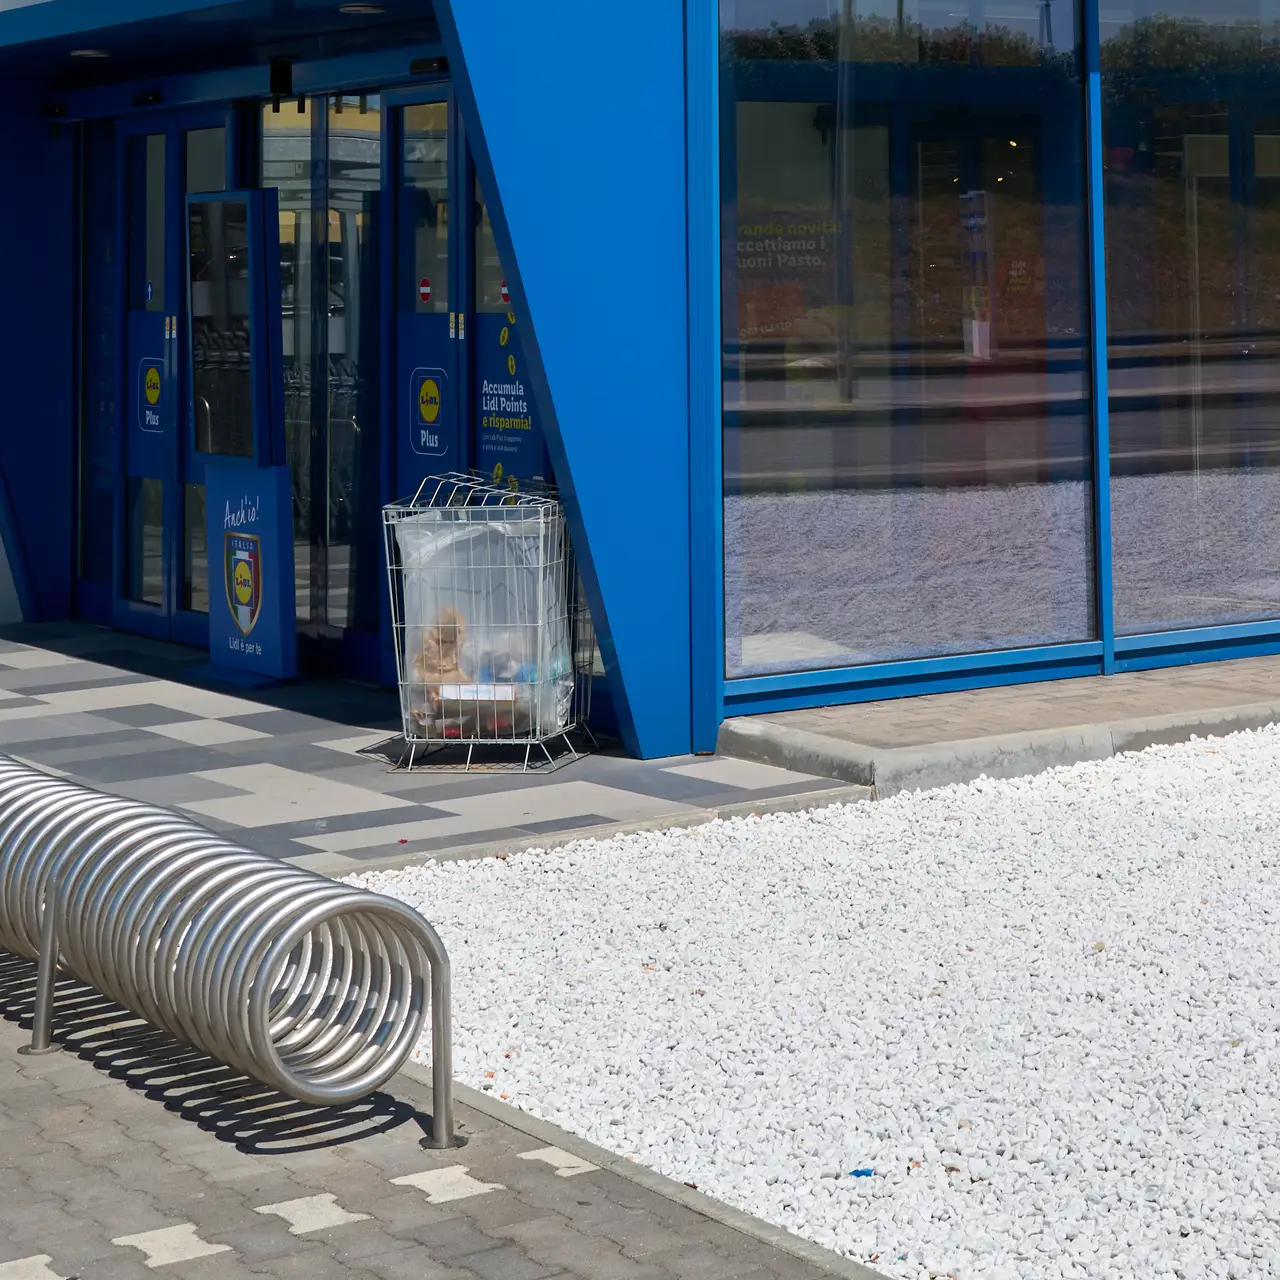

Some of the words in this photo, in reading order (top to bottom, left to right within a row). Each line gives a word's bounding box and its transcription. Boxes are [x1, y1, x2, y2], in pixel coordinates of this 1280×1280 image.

[788, 218, 842, 235] novità!
[777, 253, 826, 268] Pasto.
[482, 379, 524, 396] Accumula
[420, 392, 439, 407] LIDL
[482, 395, 498, 411] Lidl
[500, 397, 527, 413] Points
[145, 410, 160, 426] Plus
[483, 416, 488, 428] e
[489, 412, 532, 431] risparmia!
[420, 429, 439, 448] Plus
[224, 494, 260, 529] Anch'io!
[231, 539, 254, 551] ITALIA
[236, 573, 251, 588] LIDL
[228, 636, 239, 651] Lidl
[245, 642, 255, 657] per
